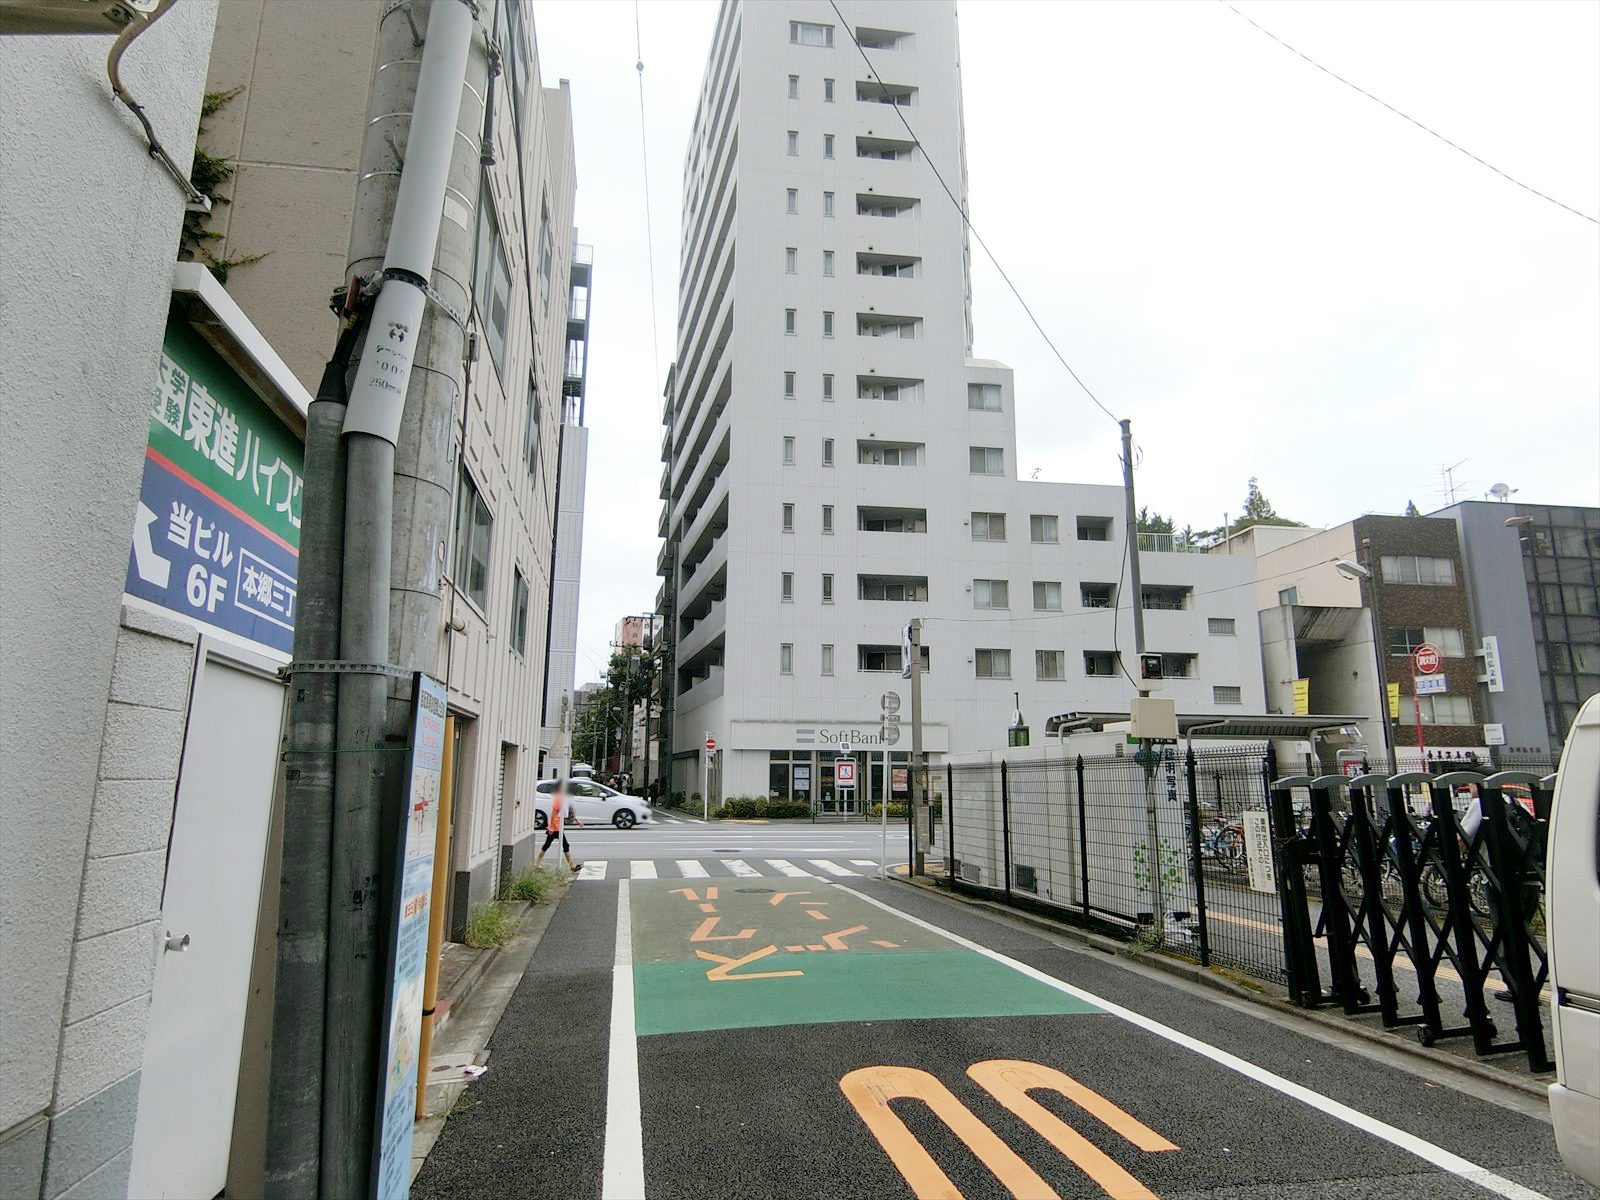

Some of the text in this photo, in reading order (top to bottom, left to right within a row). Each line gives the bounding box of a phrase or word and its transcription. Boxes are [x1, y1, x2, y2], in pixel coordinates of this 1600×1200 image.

[167, 501, 233, 570] 当ビル
[186, 562, 228, 614] 6F
